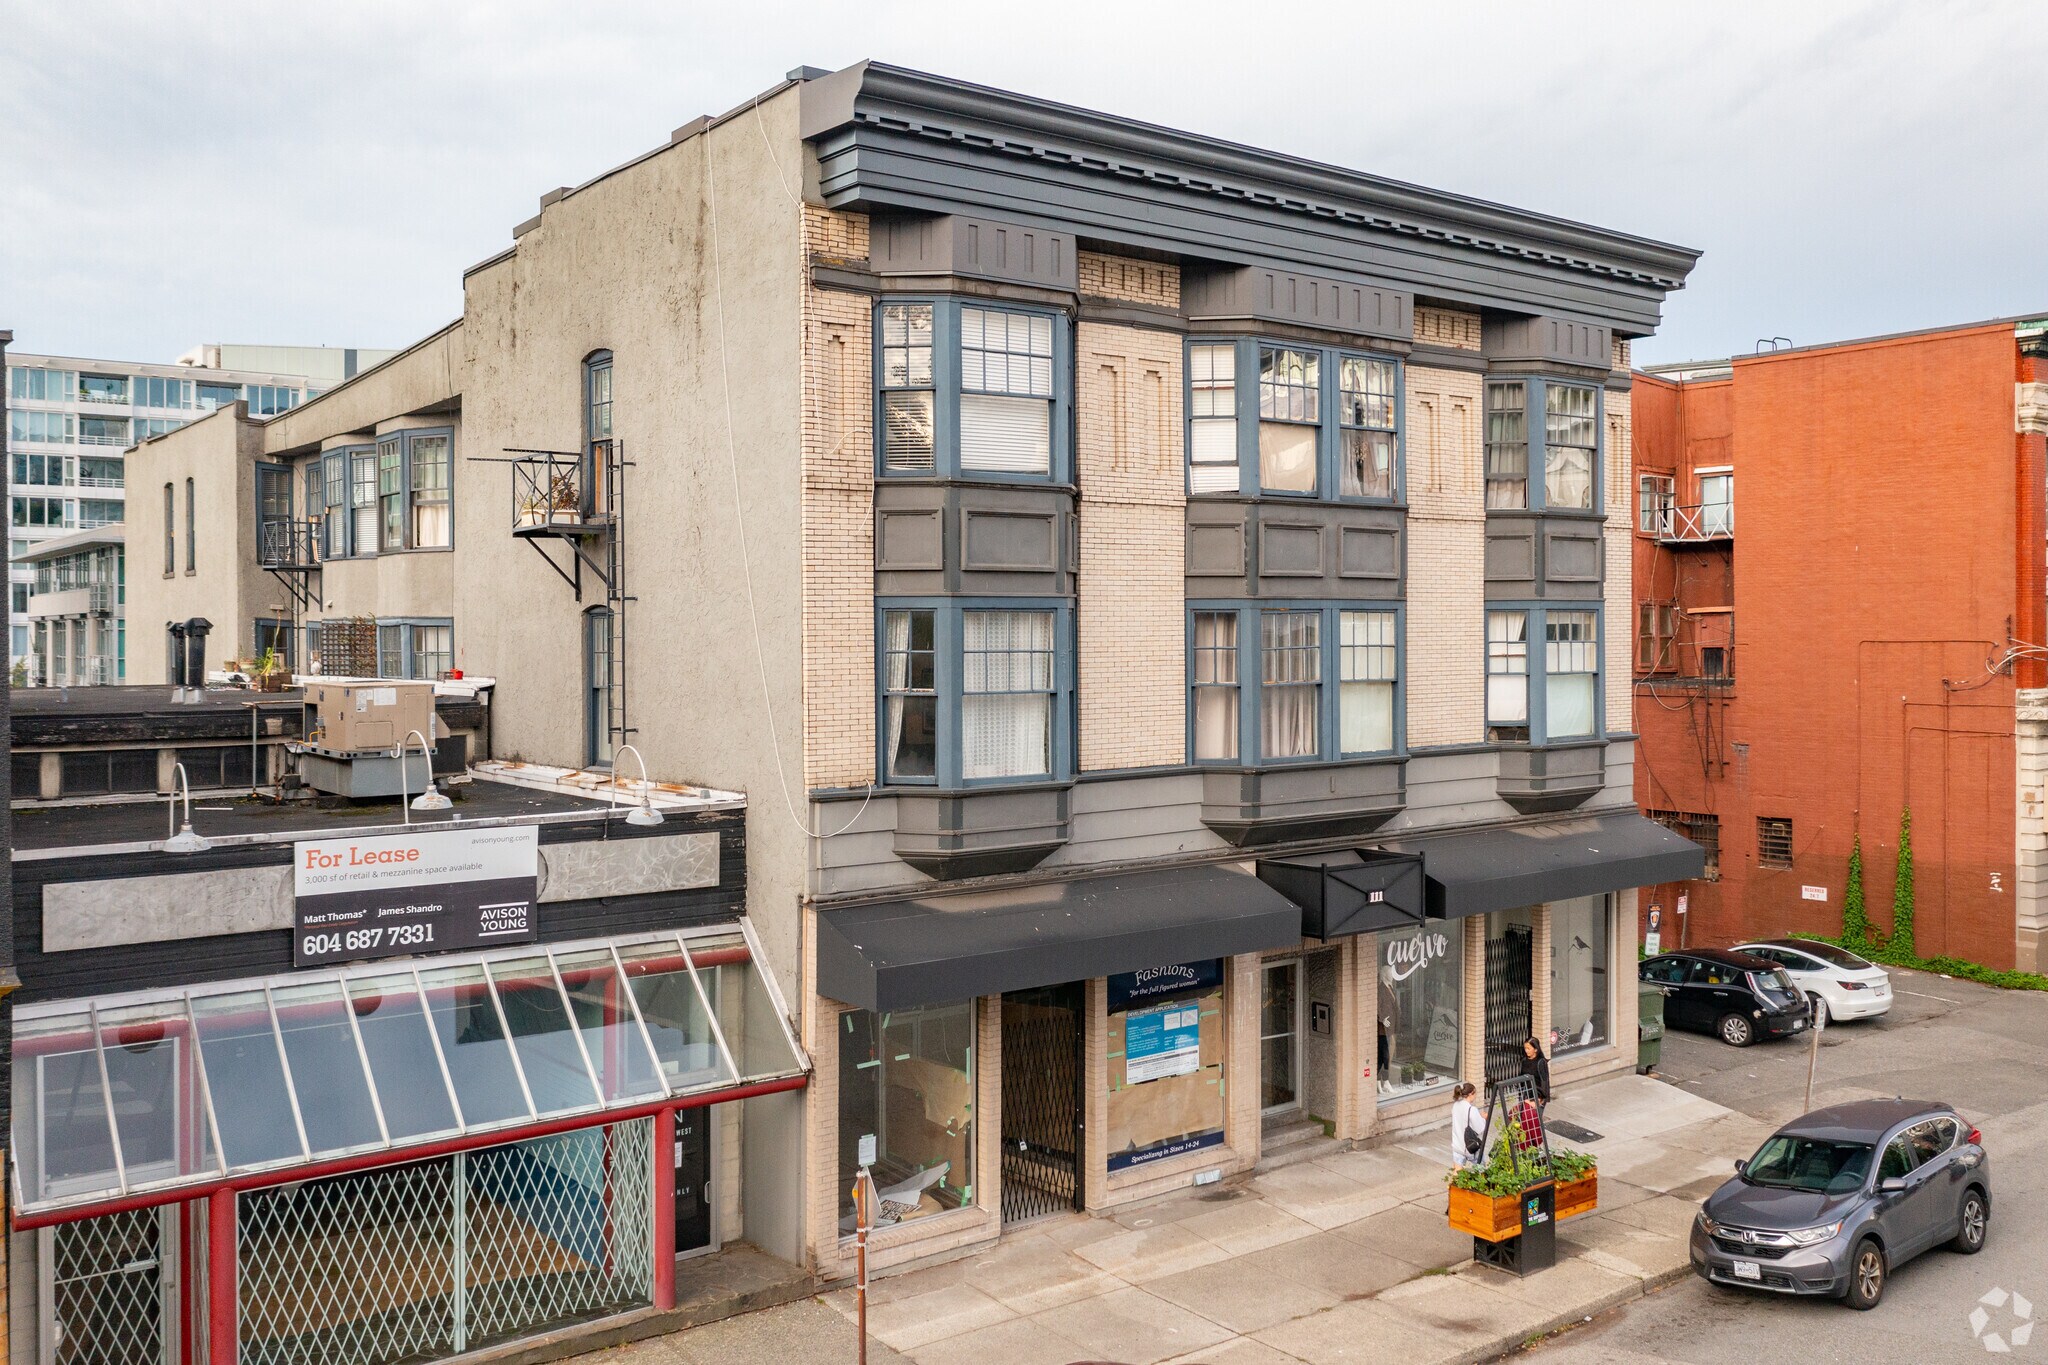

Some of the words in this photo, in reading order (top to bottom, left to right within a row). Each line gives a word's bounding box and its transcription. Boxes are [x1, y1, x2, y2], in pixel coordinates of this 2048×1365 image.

[471, 835, 530, 845] avisonyoung.com
[305, 849, 342, 869] For
[349, 846, 420, 866] Lease
[305, 874, 328, 885] 3,000
[329, 874, 338, 882] sf
[338, 873, 349, 881] of
[349, 871, 371, 881] retail
[372, 871, 379, 879] &
[380, 867, 424, 878] mezzanine
[424, 866, 448, 876] space
[448, 862, 483, 872] available
[377, 908, 405, 918] James
[406, 903, 443, 914] Shandro
[480, 907, 527, 920] AVISON
[304, 914, 326, 924] Matt
[480, 918, 527, 931] YOUNG
[303, 932, 343, 956] 604
[345, 928, 384, 951] 687
[387, 923, 435, 946] 7331
